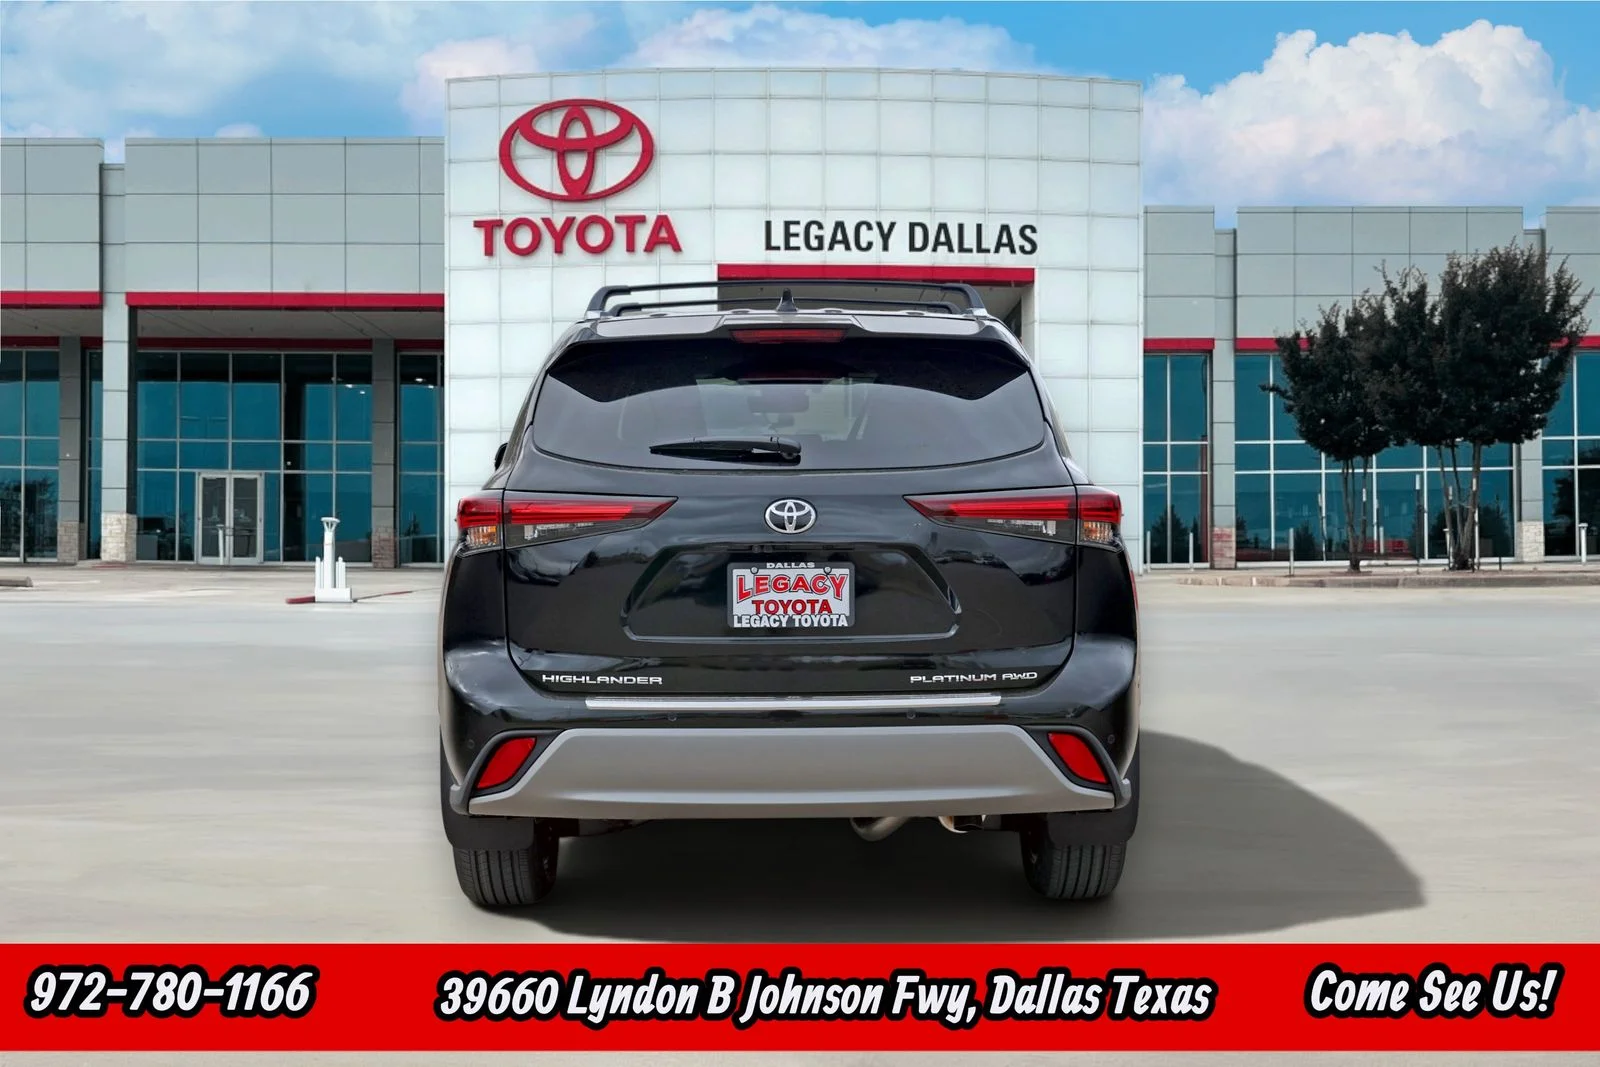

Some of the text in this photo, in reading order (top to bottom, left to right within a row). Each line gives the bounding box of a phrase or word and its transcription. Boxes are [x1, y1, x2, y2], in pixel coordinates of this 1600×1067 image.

[473, 214, 682, 257] TOYOTA
[764, 220, 1039, 256] LEGACY DALLAS
[736, 573, 849, 604] LEGACY
[751, 599, 833, 615] TOYOTA
[733, 614, 849, 628] LEGACY TOYOTA
[541, 674, 664, 685] HIGHLANDER
[909, 672, 1038, 684] PLATINUM AWD
